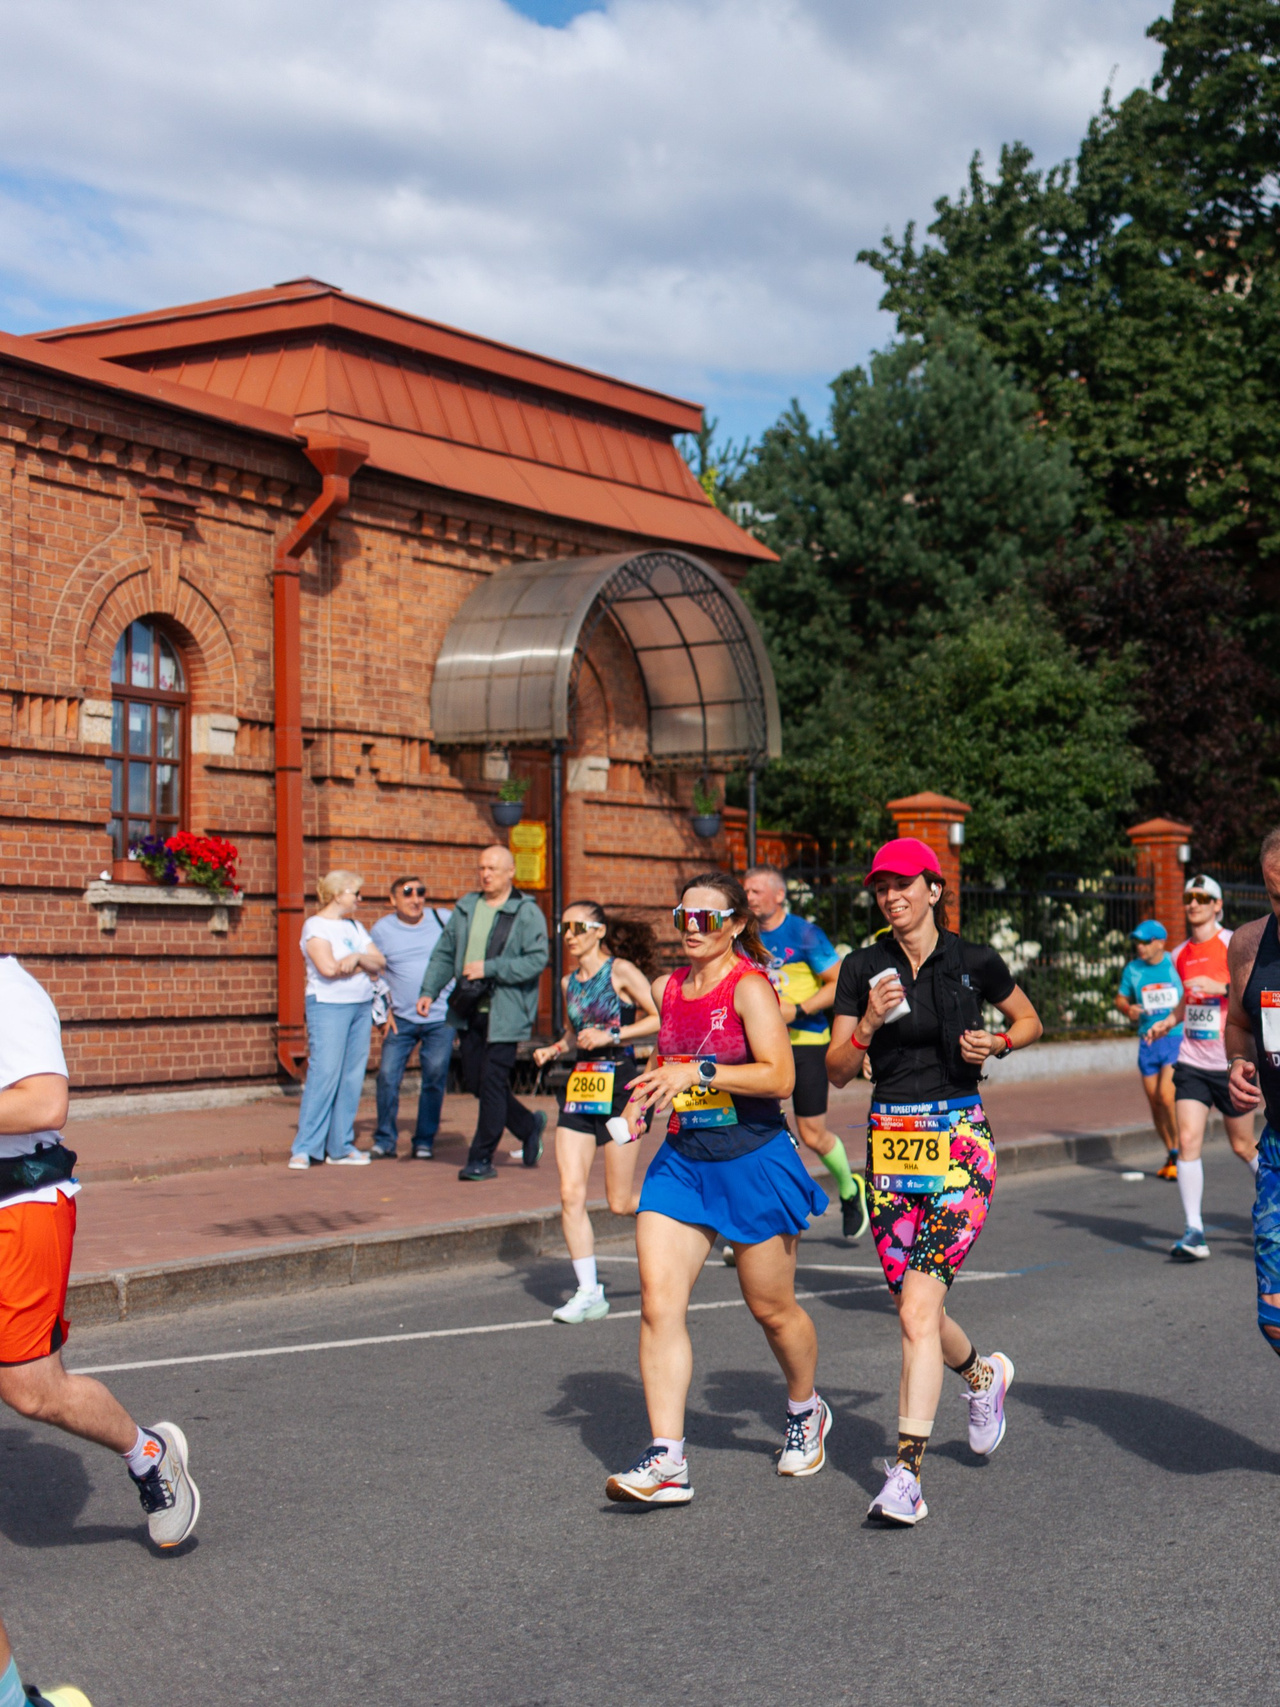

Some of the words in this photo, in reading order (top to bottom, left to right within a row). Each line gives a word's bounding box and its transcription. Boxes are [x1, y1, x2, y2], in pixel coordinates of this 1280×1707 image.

[1188, 1008, 1214, 1022] 5666
[1272, 1053, 1280, 1067] D
[573, 1077, 606, 1092] 2860
[882, 1138, 940, 1161] 3278
[880, 1175, 890, 1189] D
